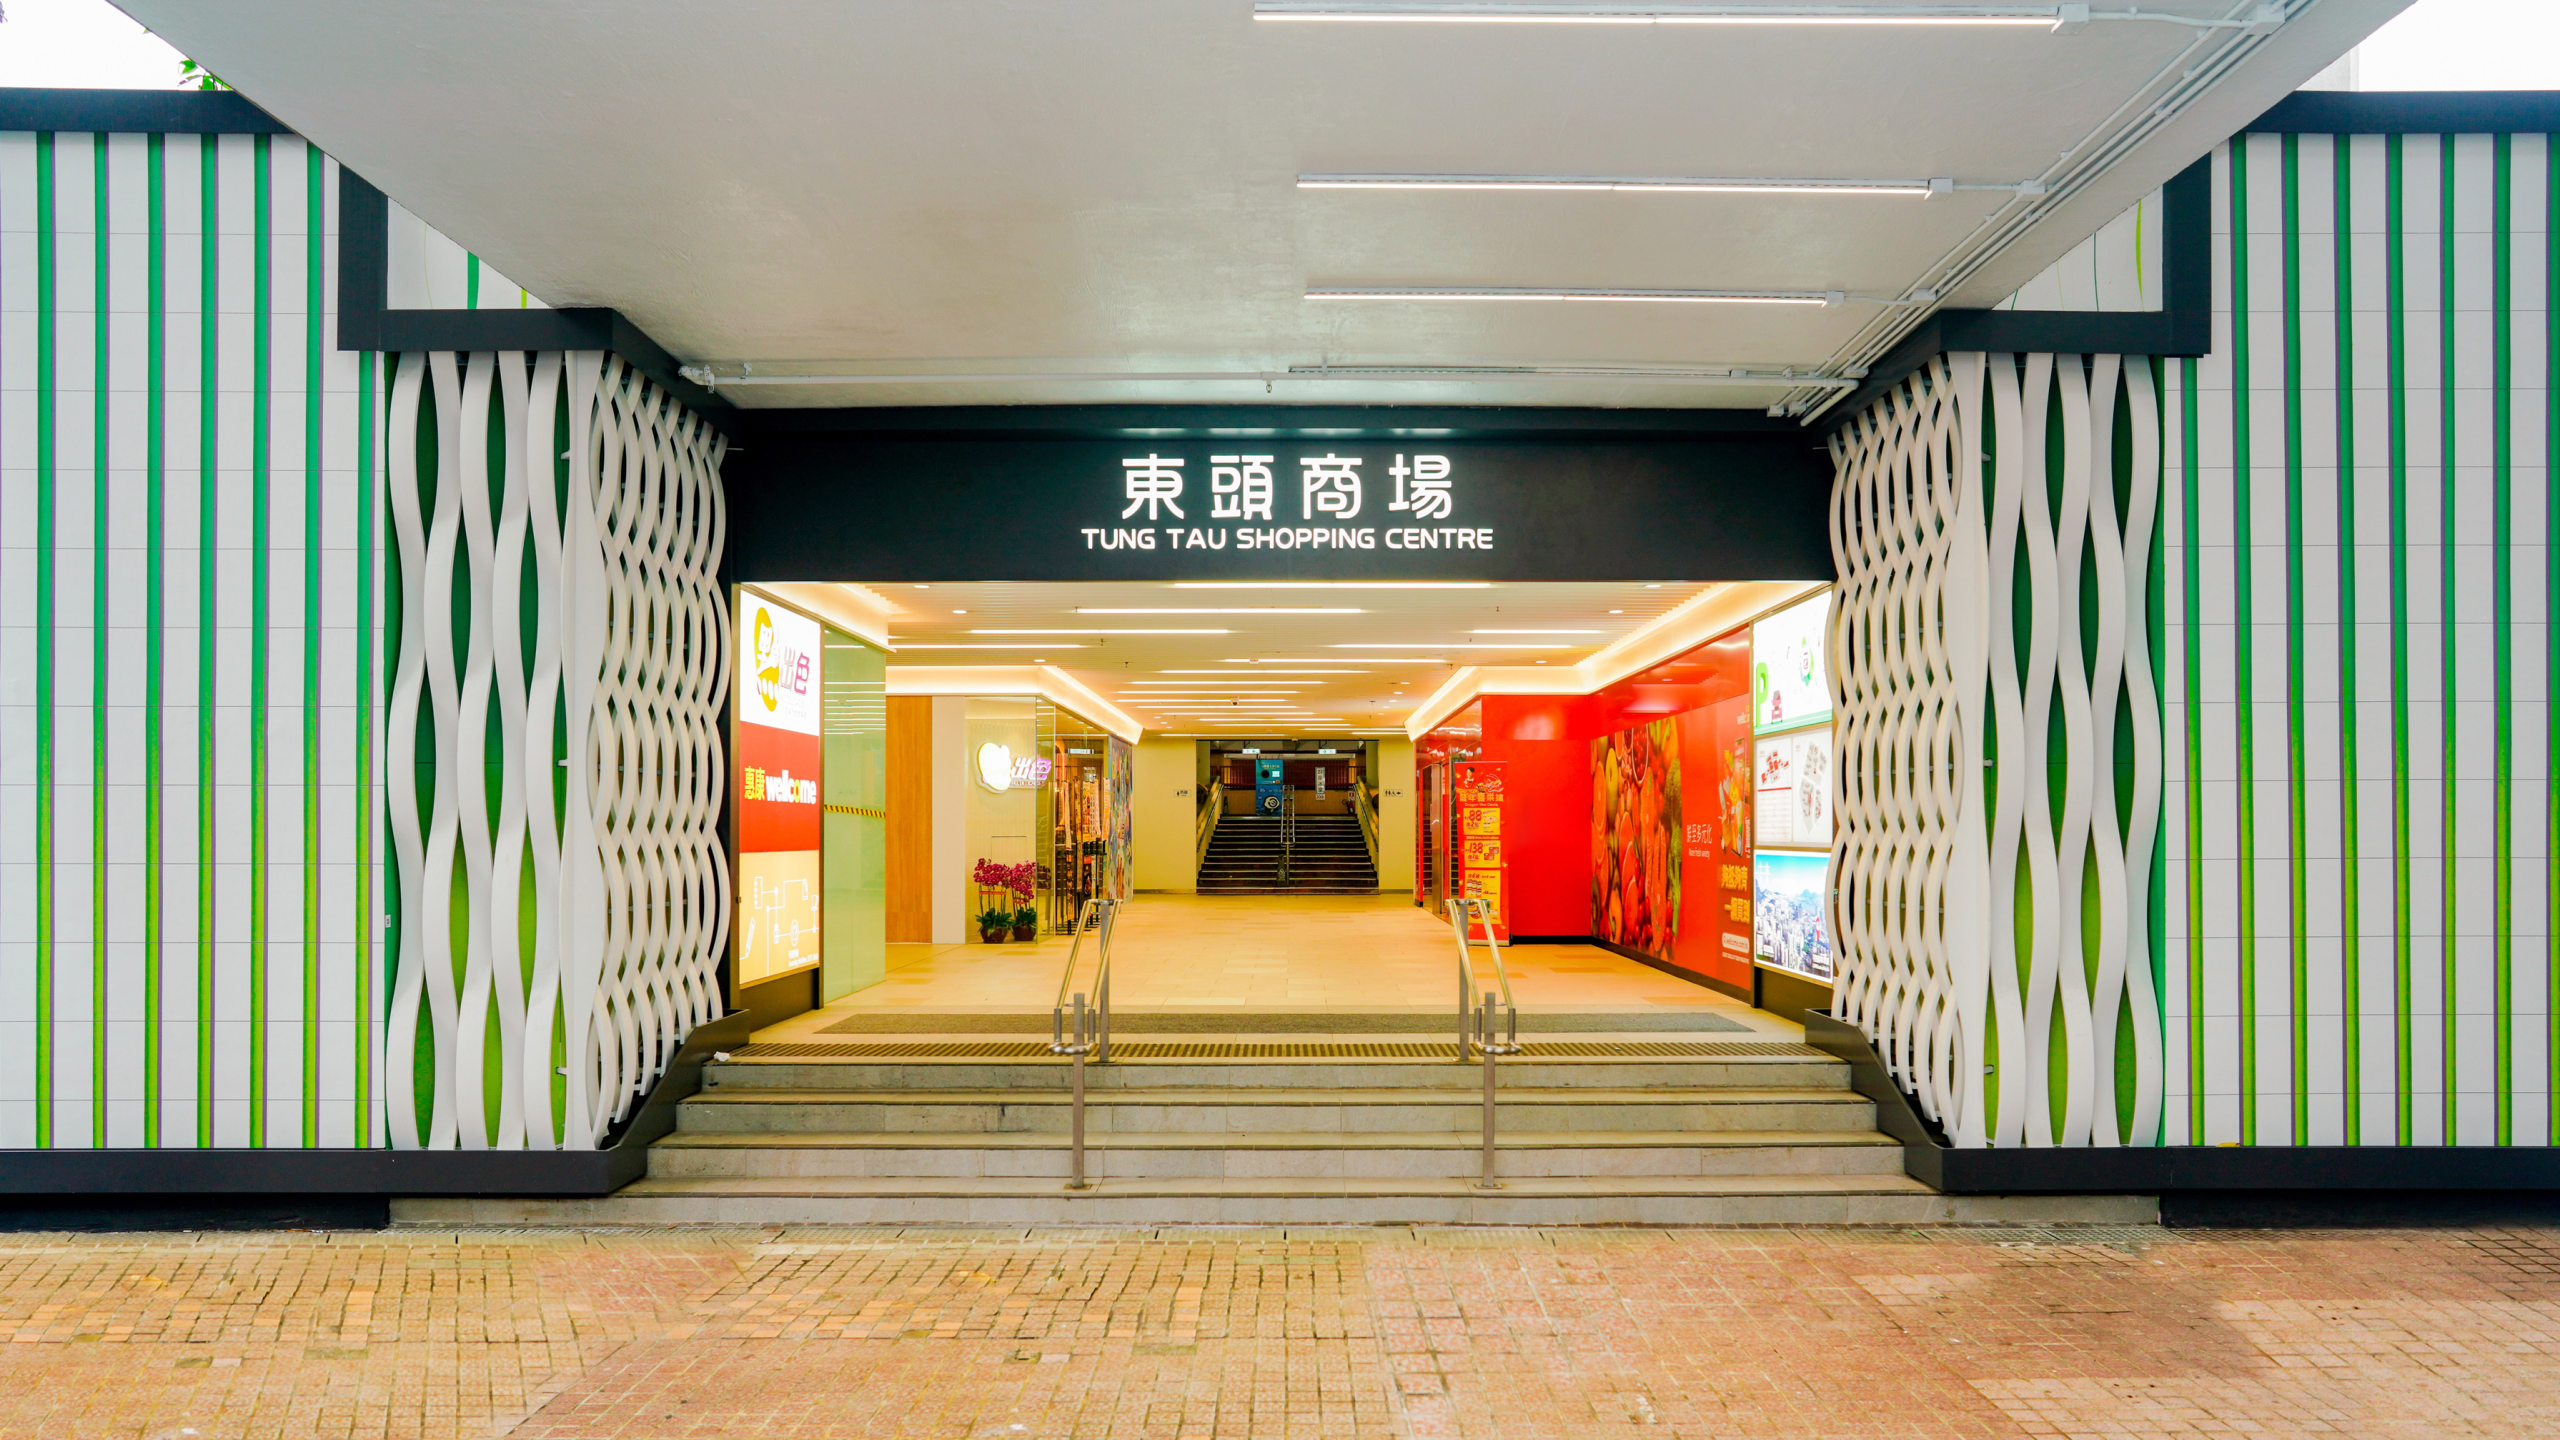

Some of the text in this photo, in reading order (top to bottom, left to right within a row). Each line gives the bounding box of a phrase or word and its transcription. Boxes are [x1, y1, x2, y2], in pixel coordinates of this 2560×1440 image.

[1121, 453, 1453, 520] 東頭商場
[1081, 527, 1494, 550] TUNG TAU SHOPPING CENTRE
[744, 765, 817, 805] 惠康 wellcome
[1686, 823, 1713, 844] 鮮至多元化
